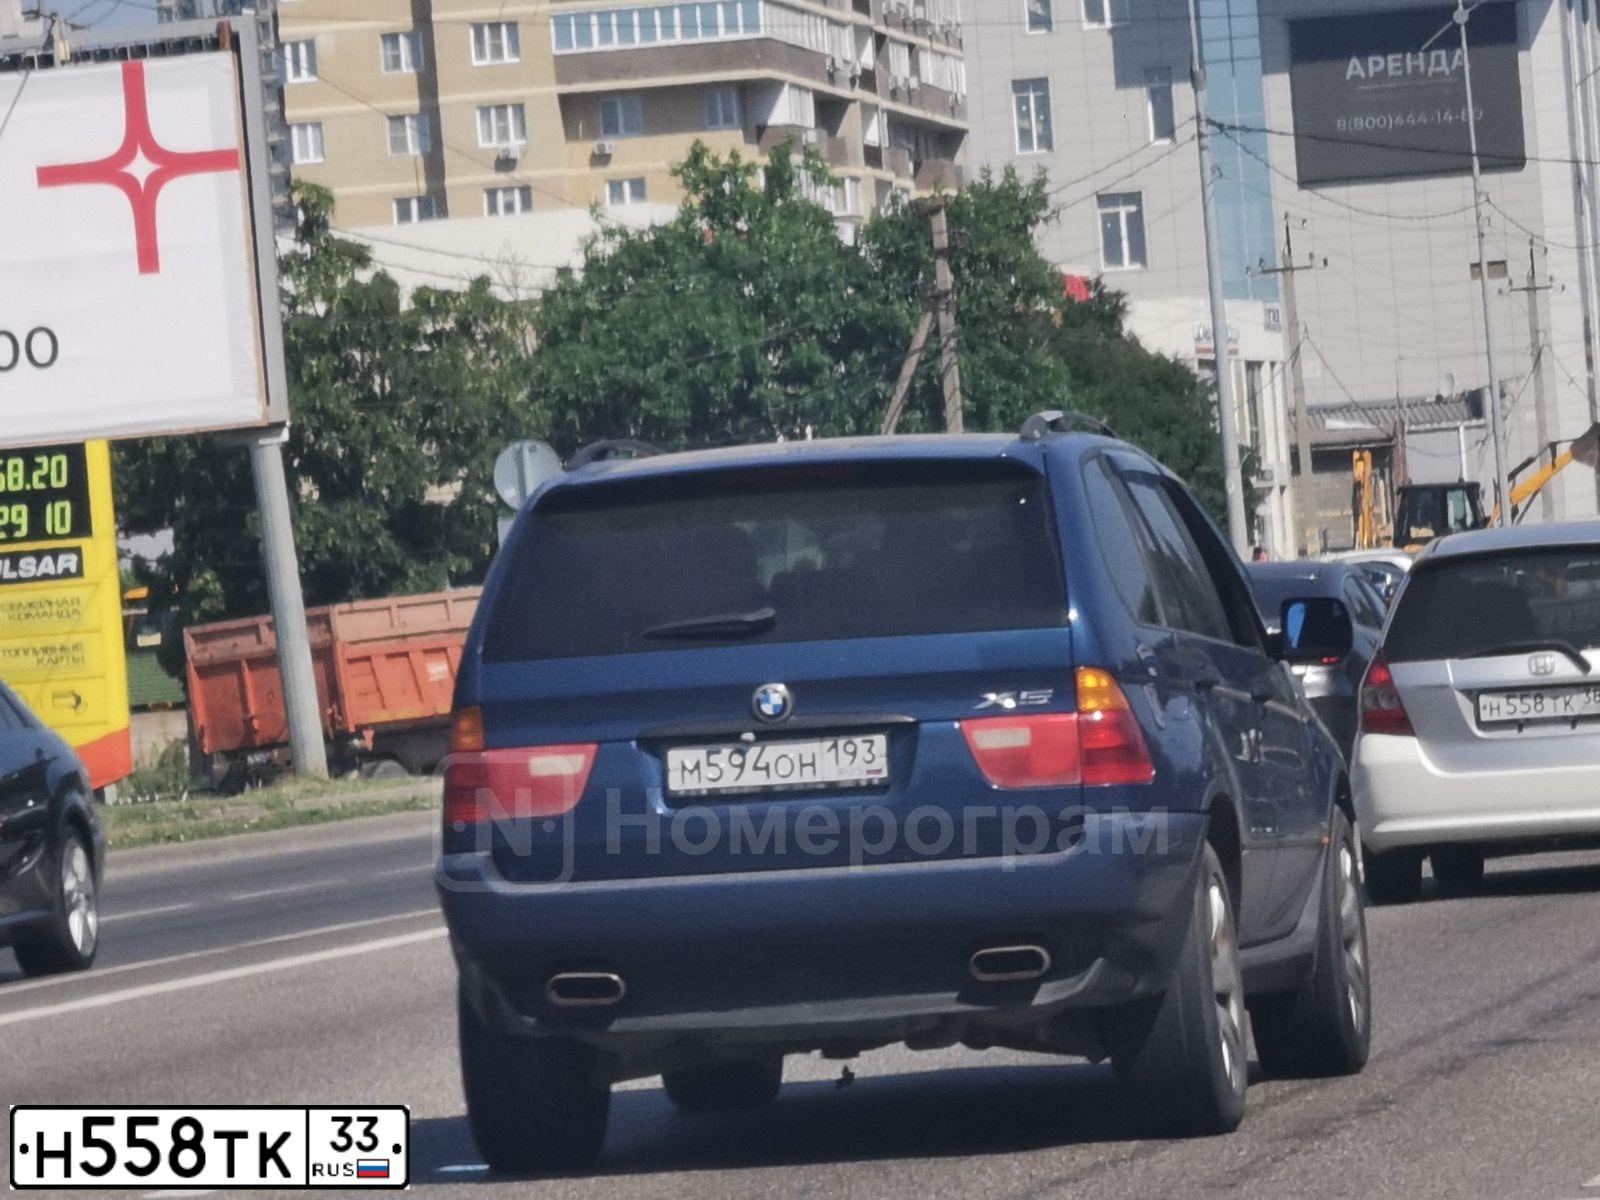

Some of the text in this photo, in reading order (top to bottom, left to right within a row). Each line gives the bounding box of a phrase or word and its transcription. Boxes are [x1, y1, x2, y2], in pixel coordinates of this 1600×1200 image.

[1345, 48, 1469, 80] АРЕНДА
[0, 553, 78, 579] LSAR
[36, 655, 85, 667] КАРТЫ
[680, 738, 876, 784] М594ОН 193
